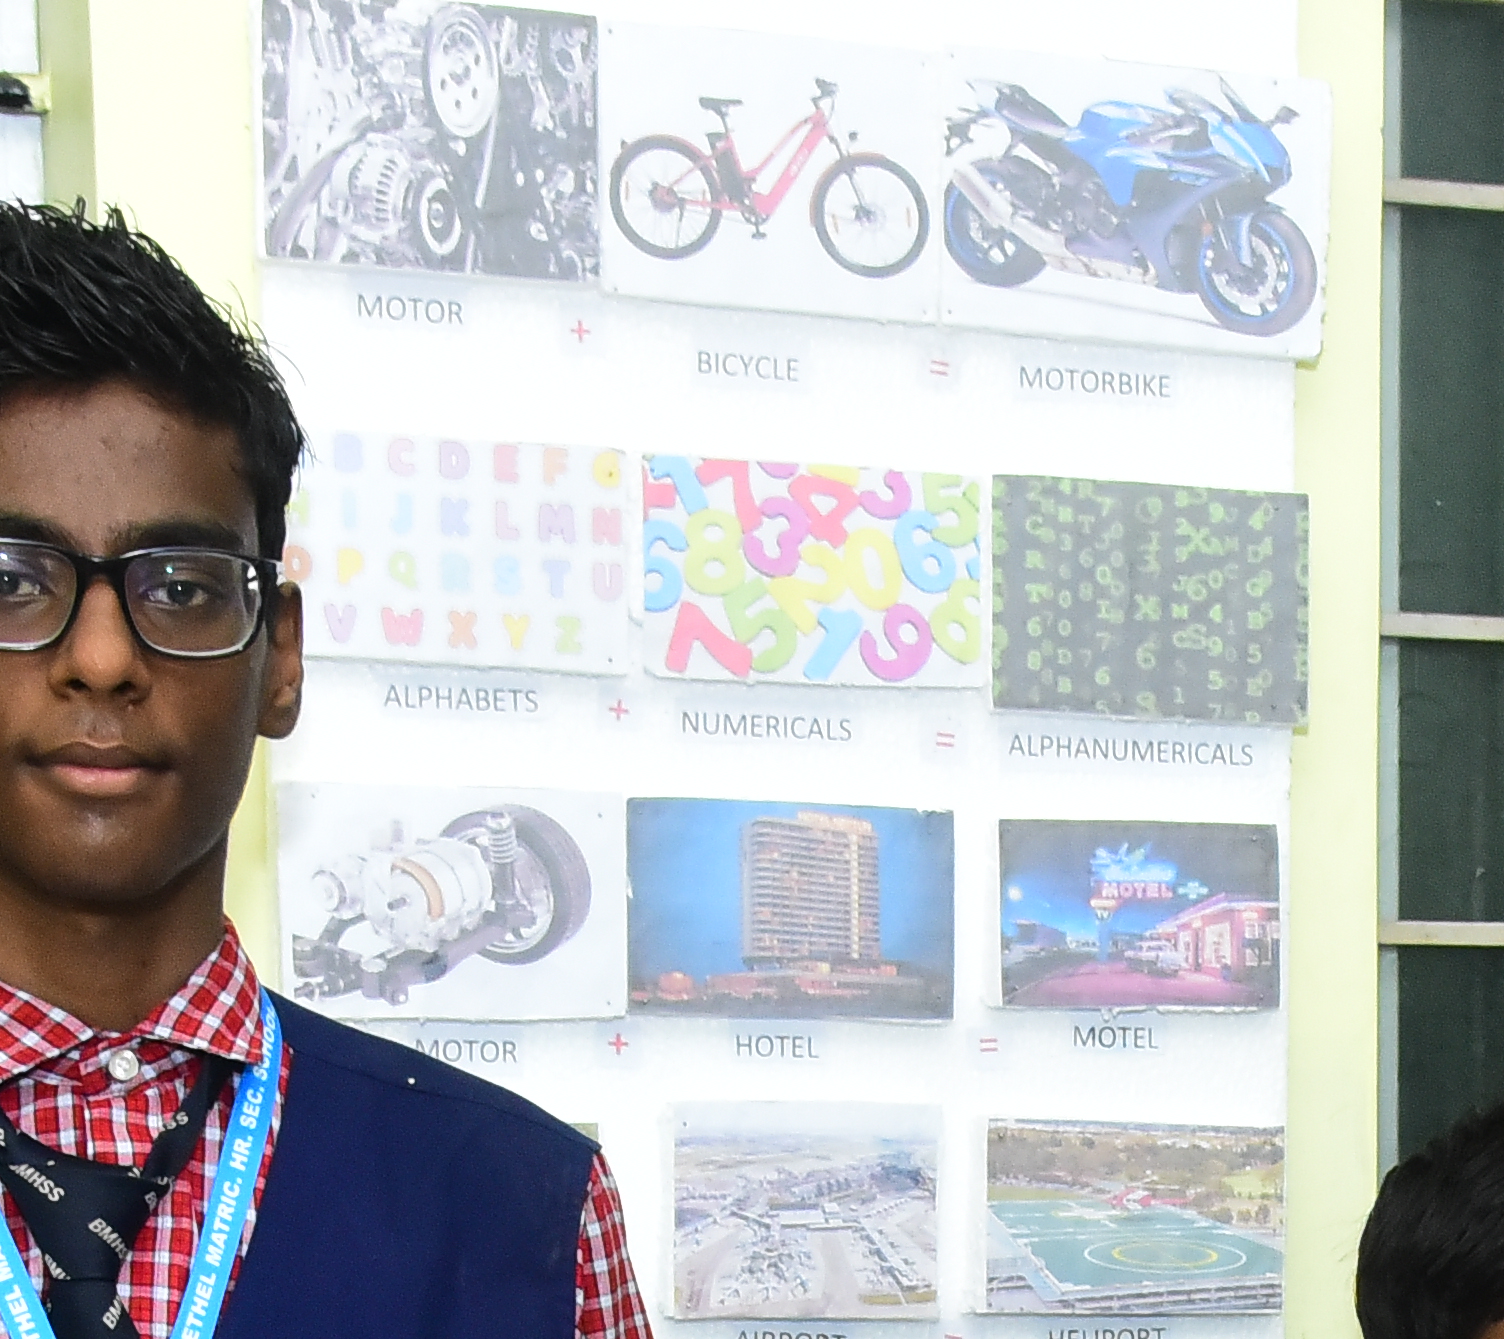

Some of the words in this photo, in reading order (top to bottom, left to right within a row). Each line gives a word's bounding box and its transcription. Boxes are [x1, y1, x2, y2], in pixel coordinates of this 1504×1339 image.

[357, 293, 463, 326] MOTOR
[697, 350, 799, 383] BICYCLE
[1019, 365, 1171, 398] MOTORBIKE
[384, 685, 538, 715] ALPHABETS
[681, 710, 853, 743] NUMERICALS
[1008, 733, 1254, 767] ALPHANUMERICALS
[1101, 882, 1173, 898] MOTEL
[414, 1038, 518, 1064] MOTOR
[735, 1033, 819, 1060] HOTEL
[1072, 1022, 1159, 1051] MOTEL
[239, 1085, 265, 1130] SEC.
[229, 1136, 253, 1171] HR.
[9, 1163, 65, 1202] MHSS
[205, 1177, 243, 1278] MATRIC.
